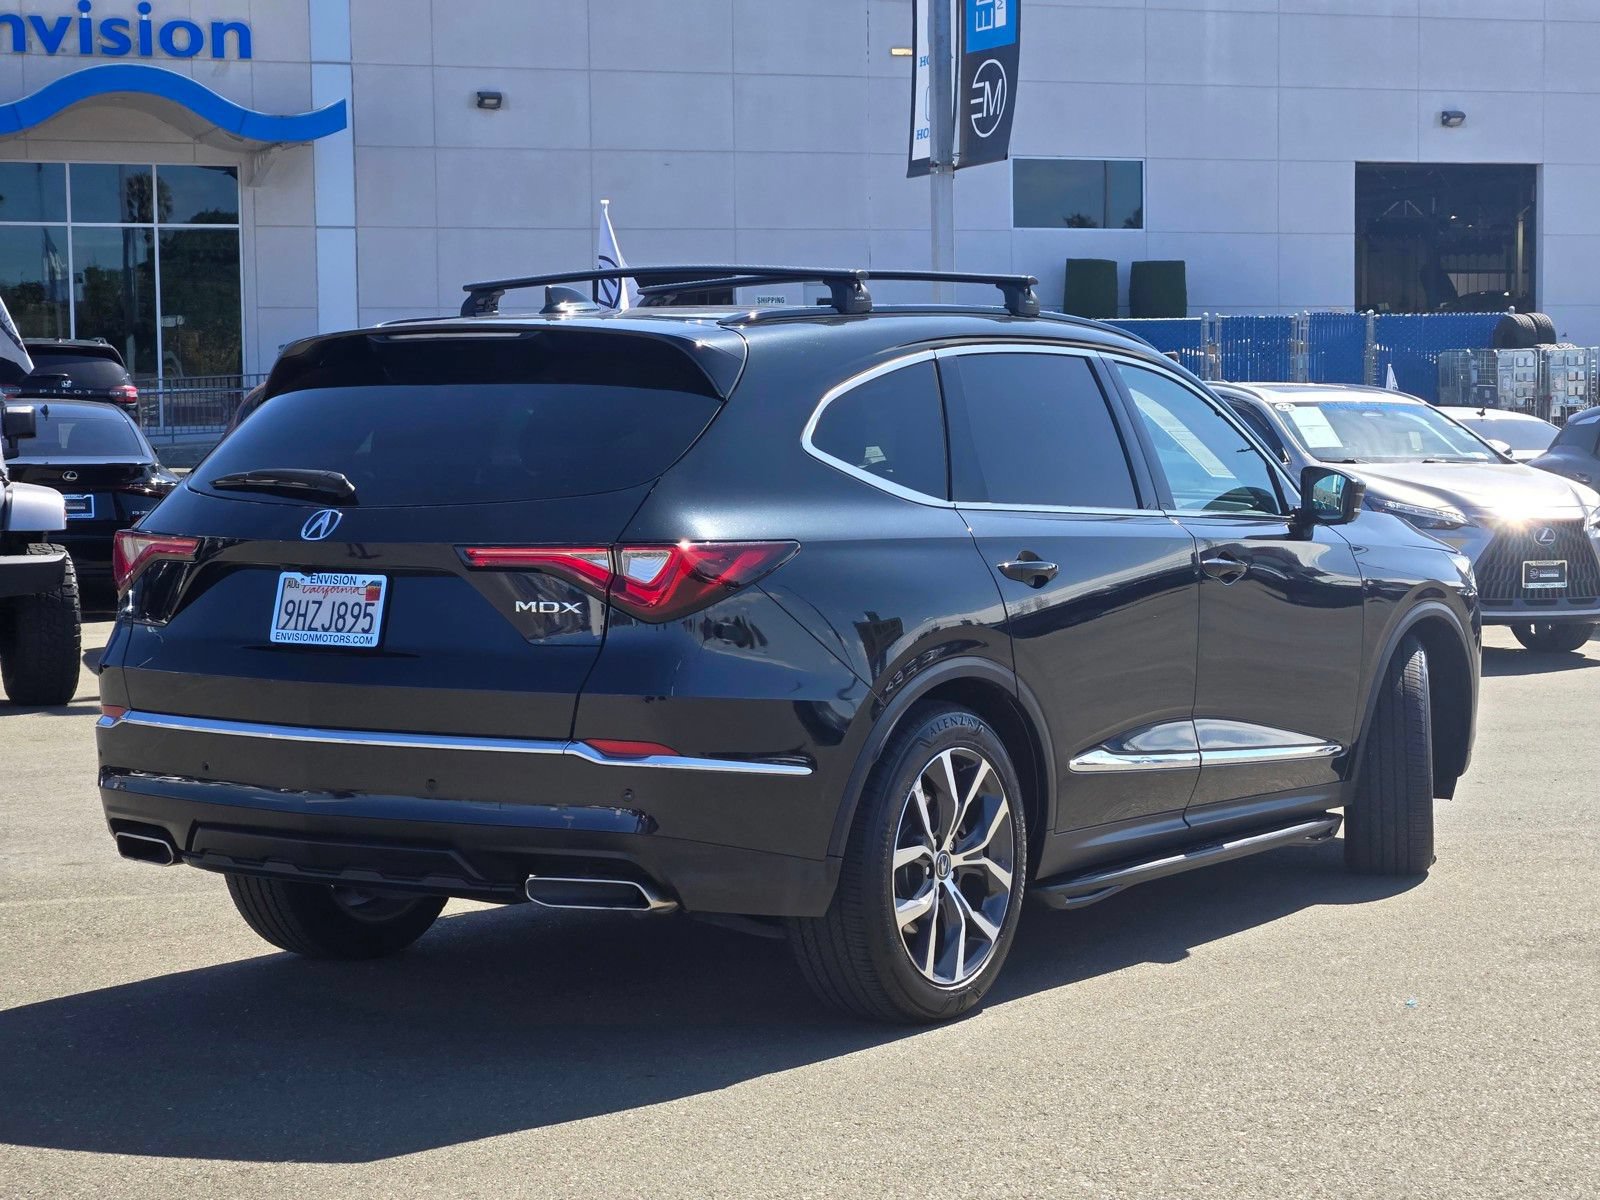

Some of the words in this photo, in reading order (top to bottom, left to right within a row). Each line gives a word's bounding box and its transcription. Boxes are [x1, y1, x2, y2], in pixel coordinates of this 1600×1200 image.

[757, 296, 785, 304] SHIPPING
[310, 574, 357, 586] ENVISION
[302, 584, 360, 599] California
[515, 600, 582, 614] MDX
[280, 599, 376, 634] 9HZJ895
[275, 631, 373, 645] ENVISIONMOTORS.COM
